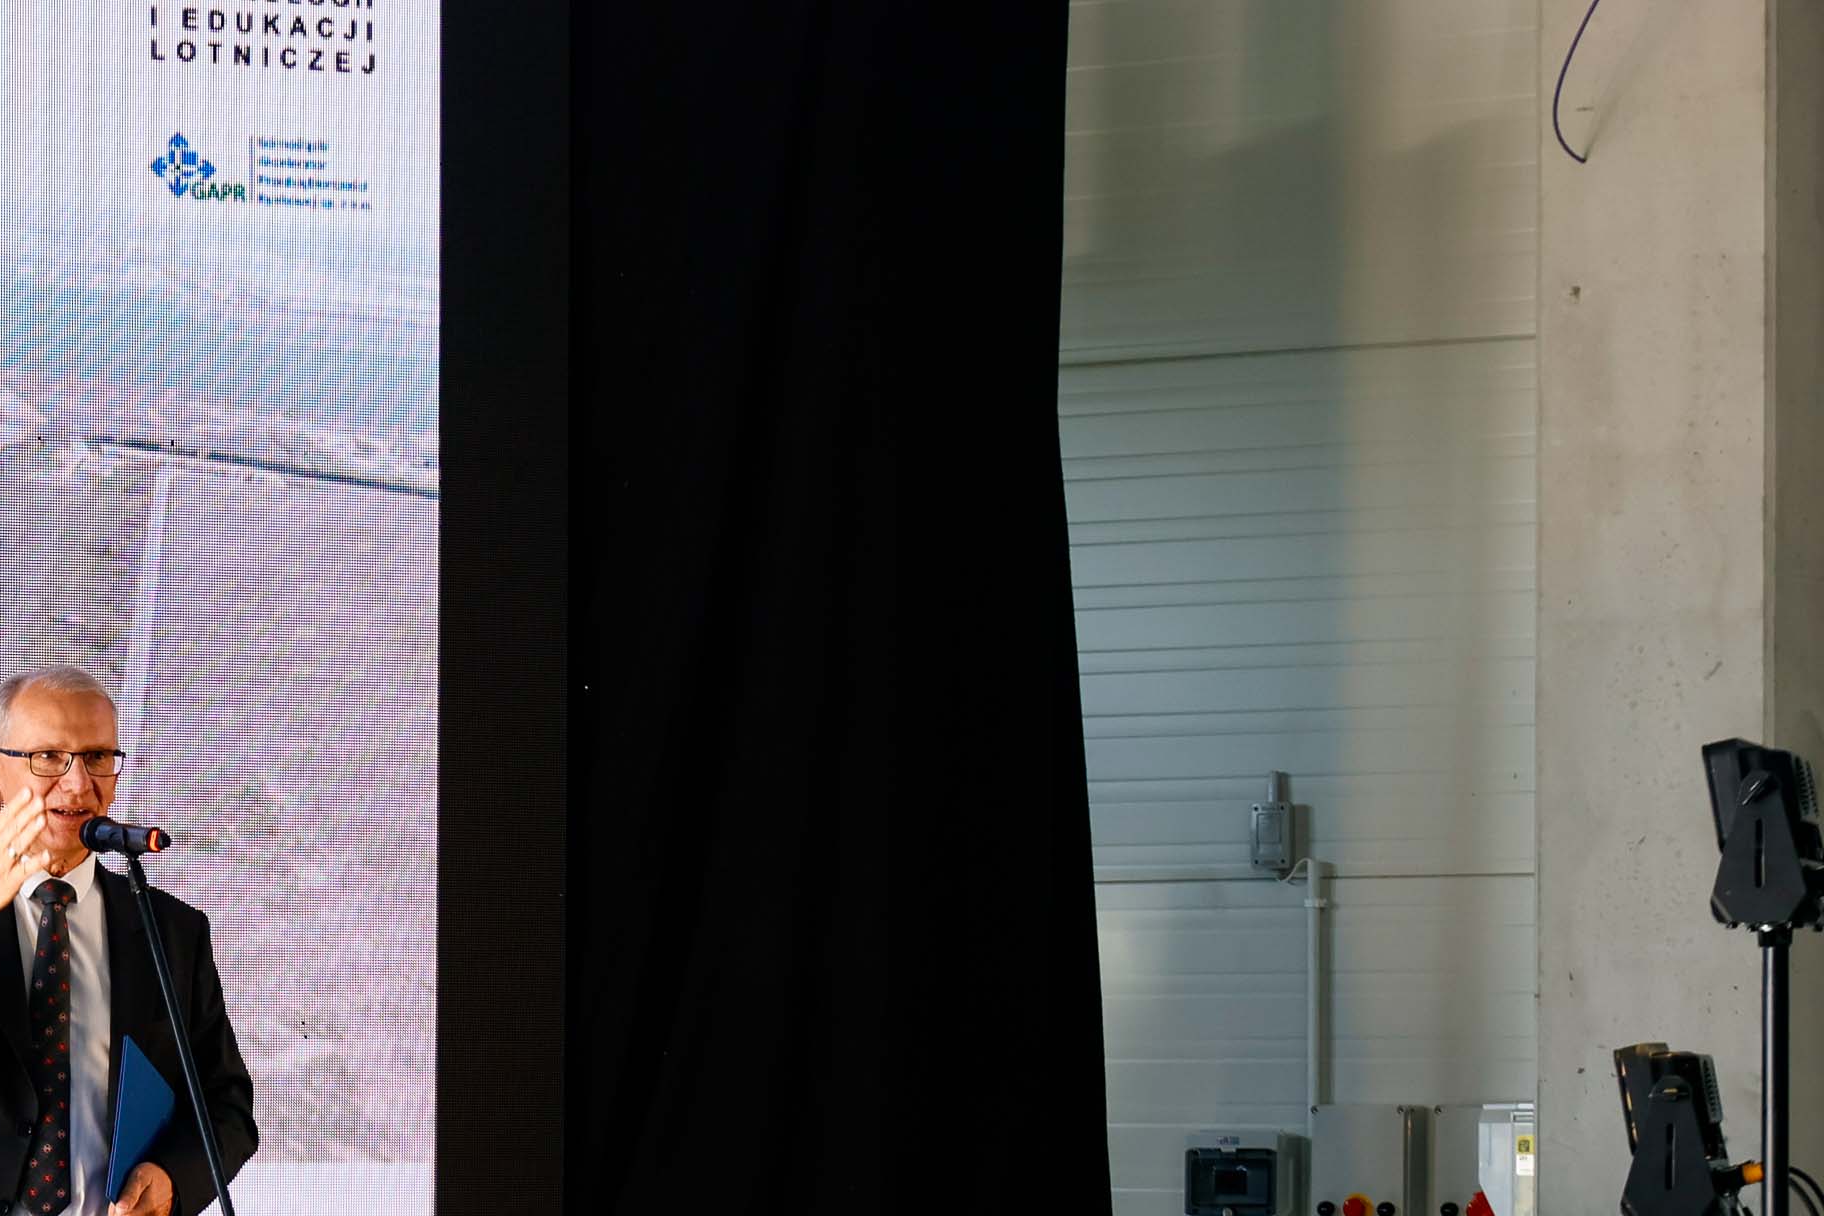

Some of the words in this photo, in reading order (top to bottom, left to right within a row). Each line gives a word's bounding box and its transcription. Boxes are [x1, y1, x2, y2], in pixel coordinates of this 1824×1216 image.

[151, 6, 157, 26] I
[182, 7, 373, 41] EDUKACJI
[151, 39, 375, 74] LOTNICZEJ
